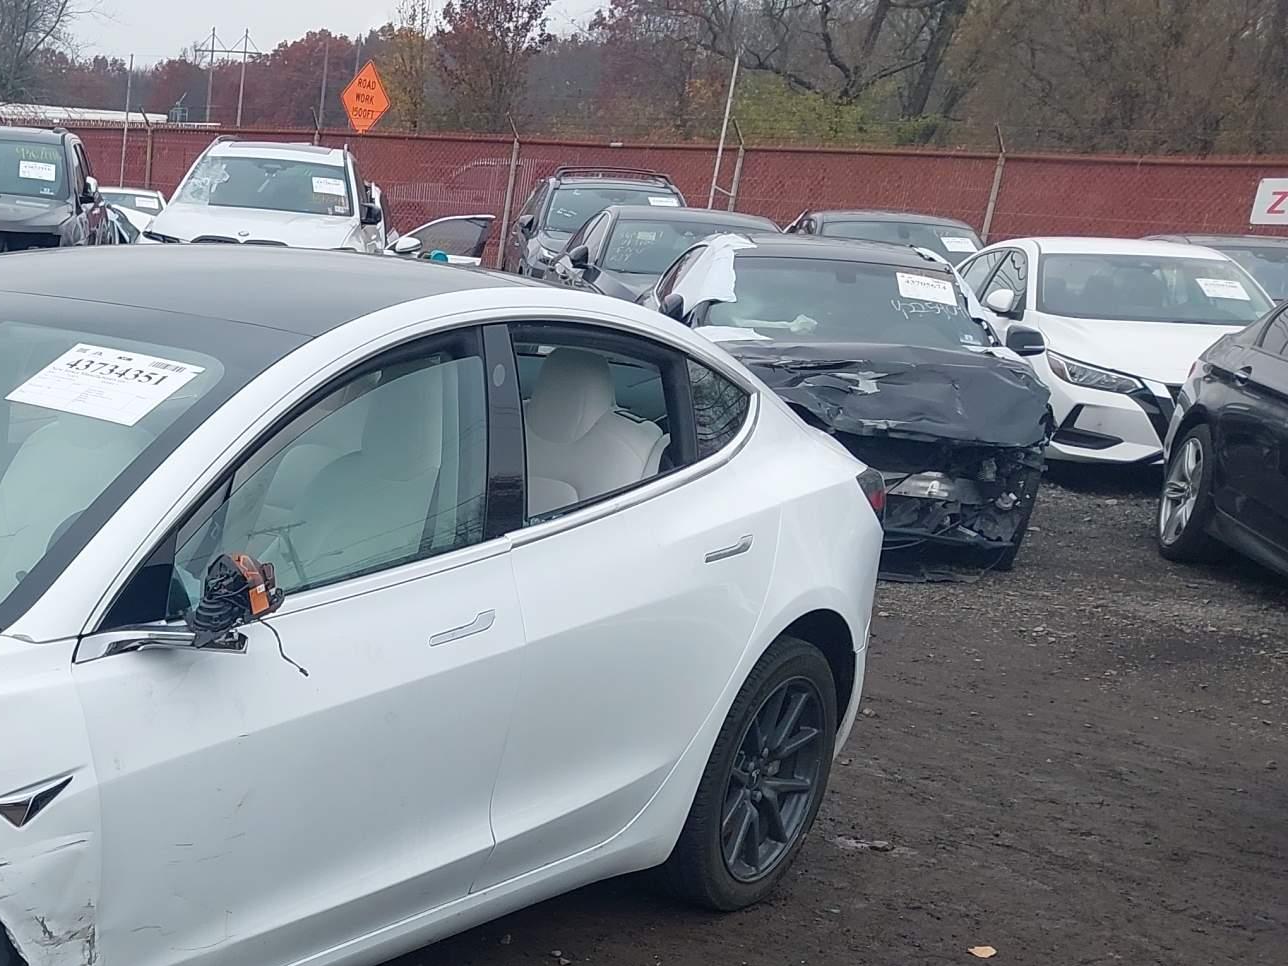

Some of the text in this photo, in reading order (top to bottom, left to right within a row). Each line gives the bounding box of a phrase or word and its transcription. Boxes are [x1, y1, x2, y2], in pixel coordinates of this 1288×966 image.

[357, 78, 377, 90] ROAD
[355, 93, 375, 105] WORK
[66, 358, 169, 385] 43734351
